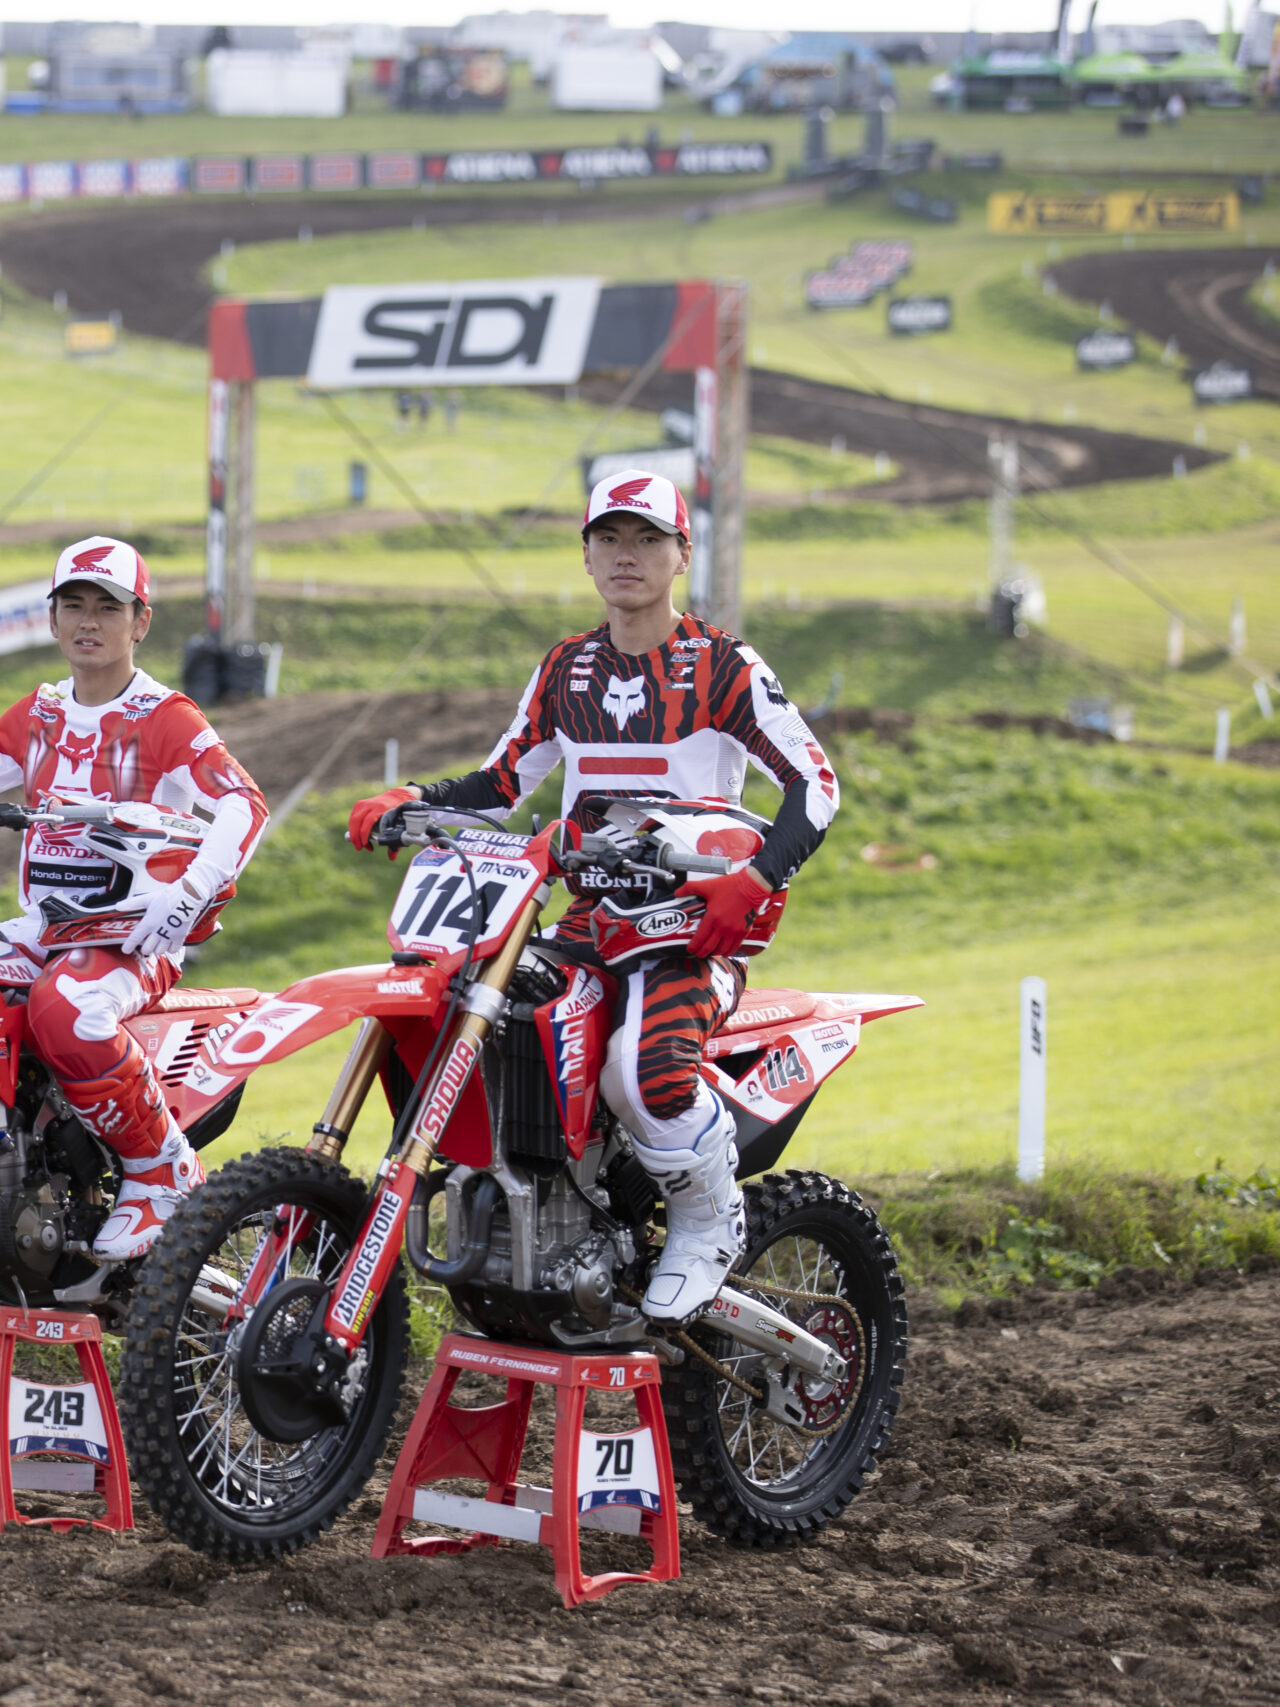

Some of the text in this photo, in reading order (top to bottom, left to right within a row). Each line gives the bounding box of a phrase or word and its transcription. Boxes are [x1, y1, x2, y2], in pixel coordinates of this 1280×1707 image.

[606, 500, 652, 509] HONDA
[70, 565, 112, 576] HONDA
[460, 829, 532, 847] RENTHAL
[34, 844, 108, 859] HONDA
[30, 869, 106, 882] Honda Dream
[580, 873, 651, 888] HOND
[397, 873, 508, 945] 114
[157, 901, 194, 940] FOX
[642, 911, 679, 930] Arai
[410, 943, 444, 953] HONDA
[377, 980, 424, 995] MOTUL
[565, 990, 600, 1016] JAPAN
[727, 1005, 796, 1025] HONDA
[814, 1026, 842, 1040] MOTUL
[559, 1019, 585, 1082] CRF
[763, 1046, 807, 1091] 114
[422, 1042, 475, 1141] SHOWA
[333, 1192, 400, 1327] BRIDGESTONE
[36, 1320, 64, 1339] 243
[450, 1349, 559, 1376] RUBEN FERNANDEZ
[609, 1367, 626, 1386] 70
[24, 1388, 85, 1426] 243
[596, 1439, 634, 1476] 70
